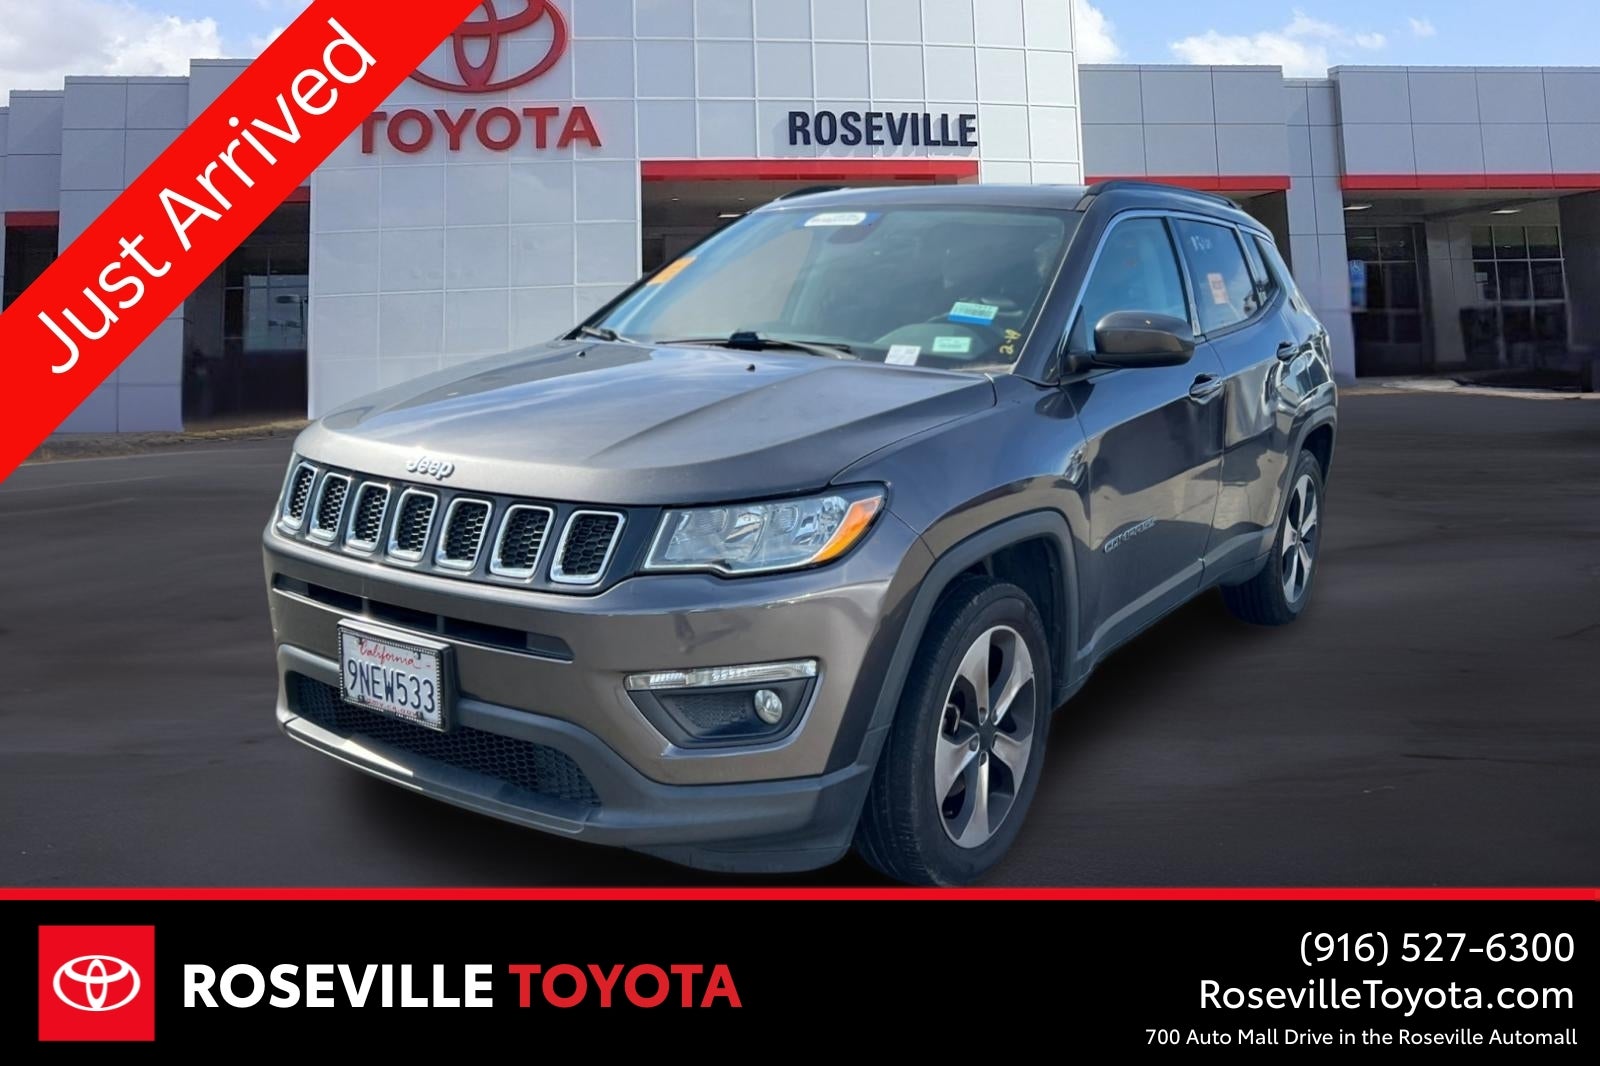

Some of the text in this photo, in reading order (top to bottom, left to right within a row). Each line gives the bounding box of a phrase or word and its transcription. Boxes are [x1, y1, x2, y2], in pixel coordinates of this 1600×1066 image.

[361, 106, 602, 154] TOYOTA
[788, 110, 978, 147] ROSEVILLE
[406, 455, 455, 480] Jeep
[347, 659, 436, 714] 9NEW533
